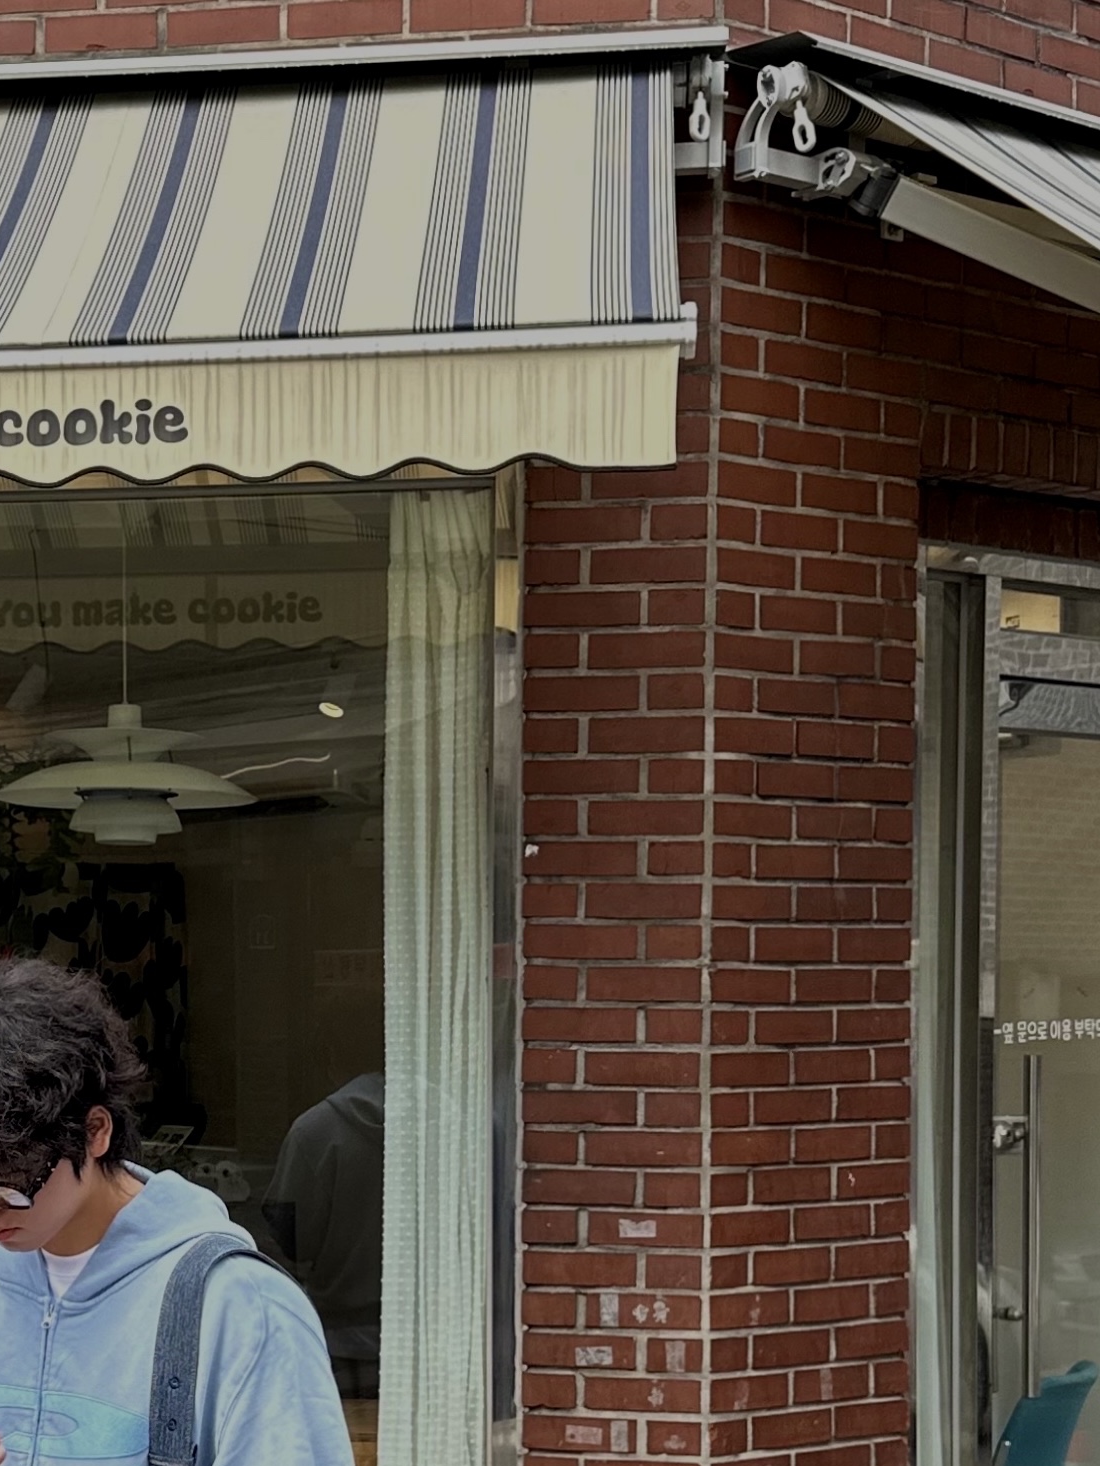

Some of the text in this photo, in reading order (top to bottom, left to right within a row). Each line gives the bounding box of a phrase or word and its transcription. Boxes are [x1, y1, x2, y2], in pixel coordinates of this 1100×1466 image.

[71, 592, 175, 627] make
[186, 590, 322, 624] cookie
[1017, 1021, 1048, 1043] 문으로
[1050, 1019, 1072, 1041] 이용
